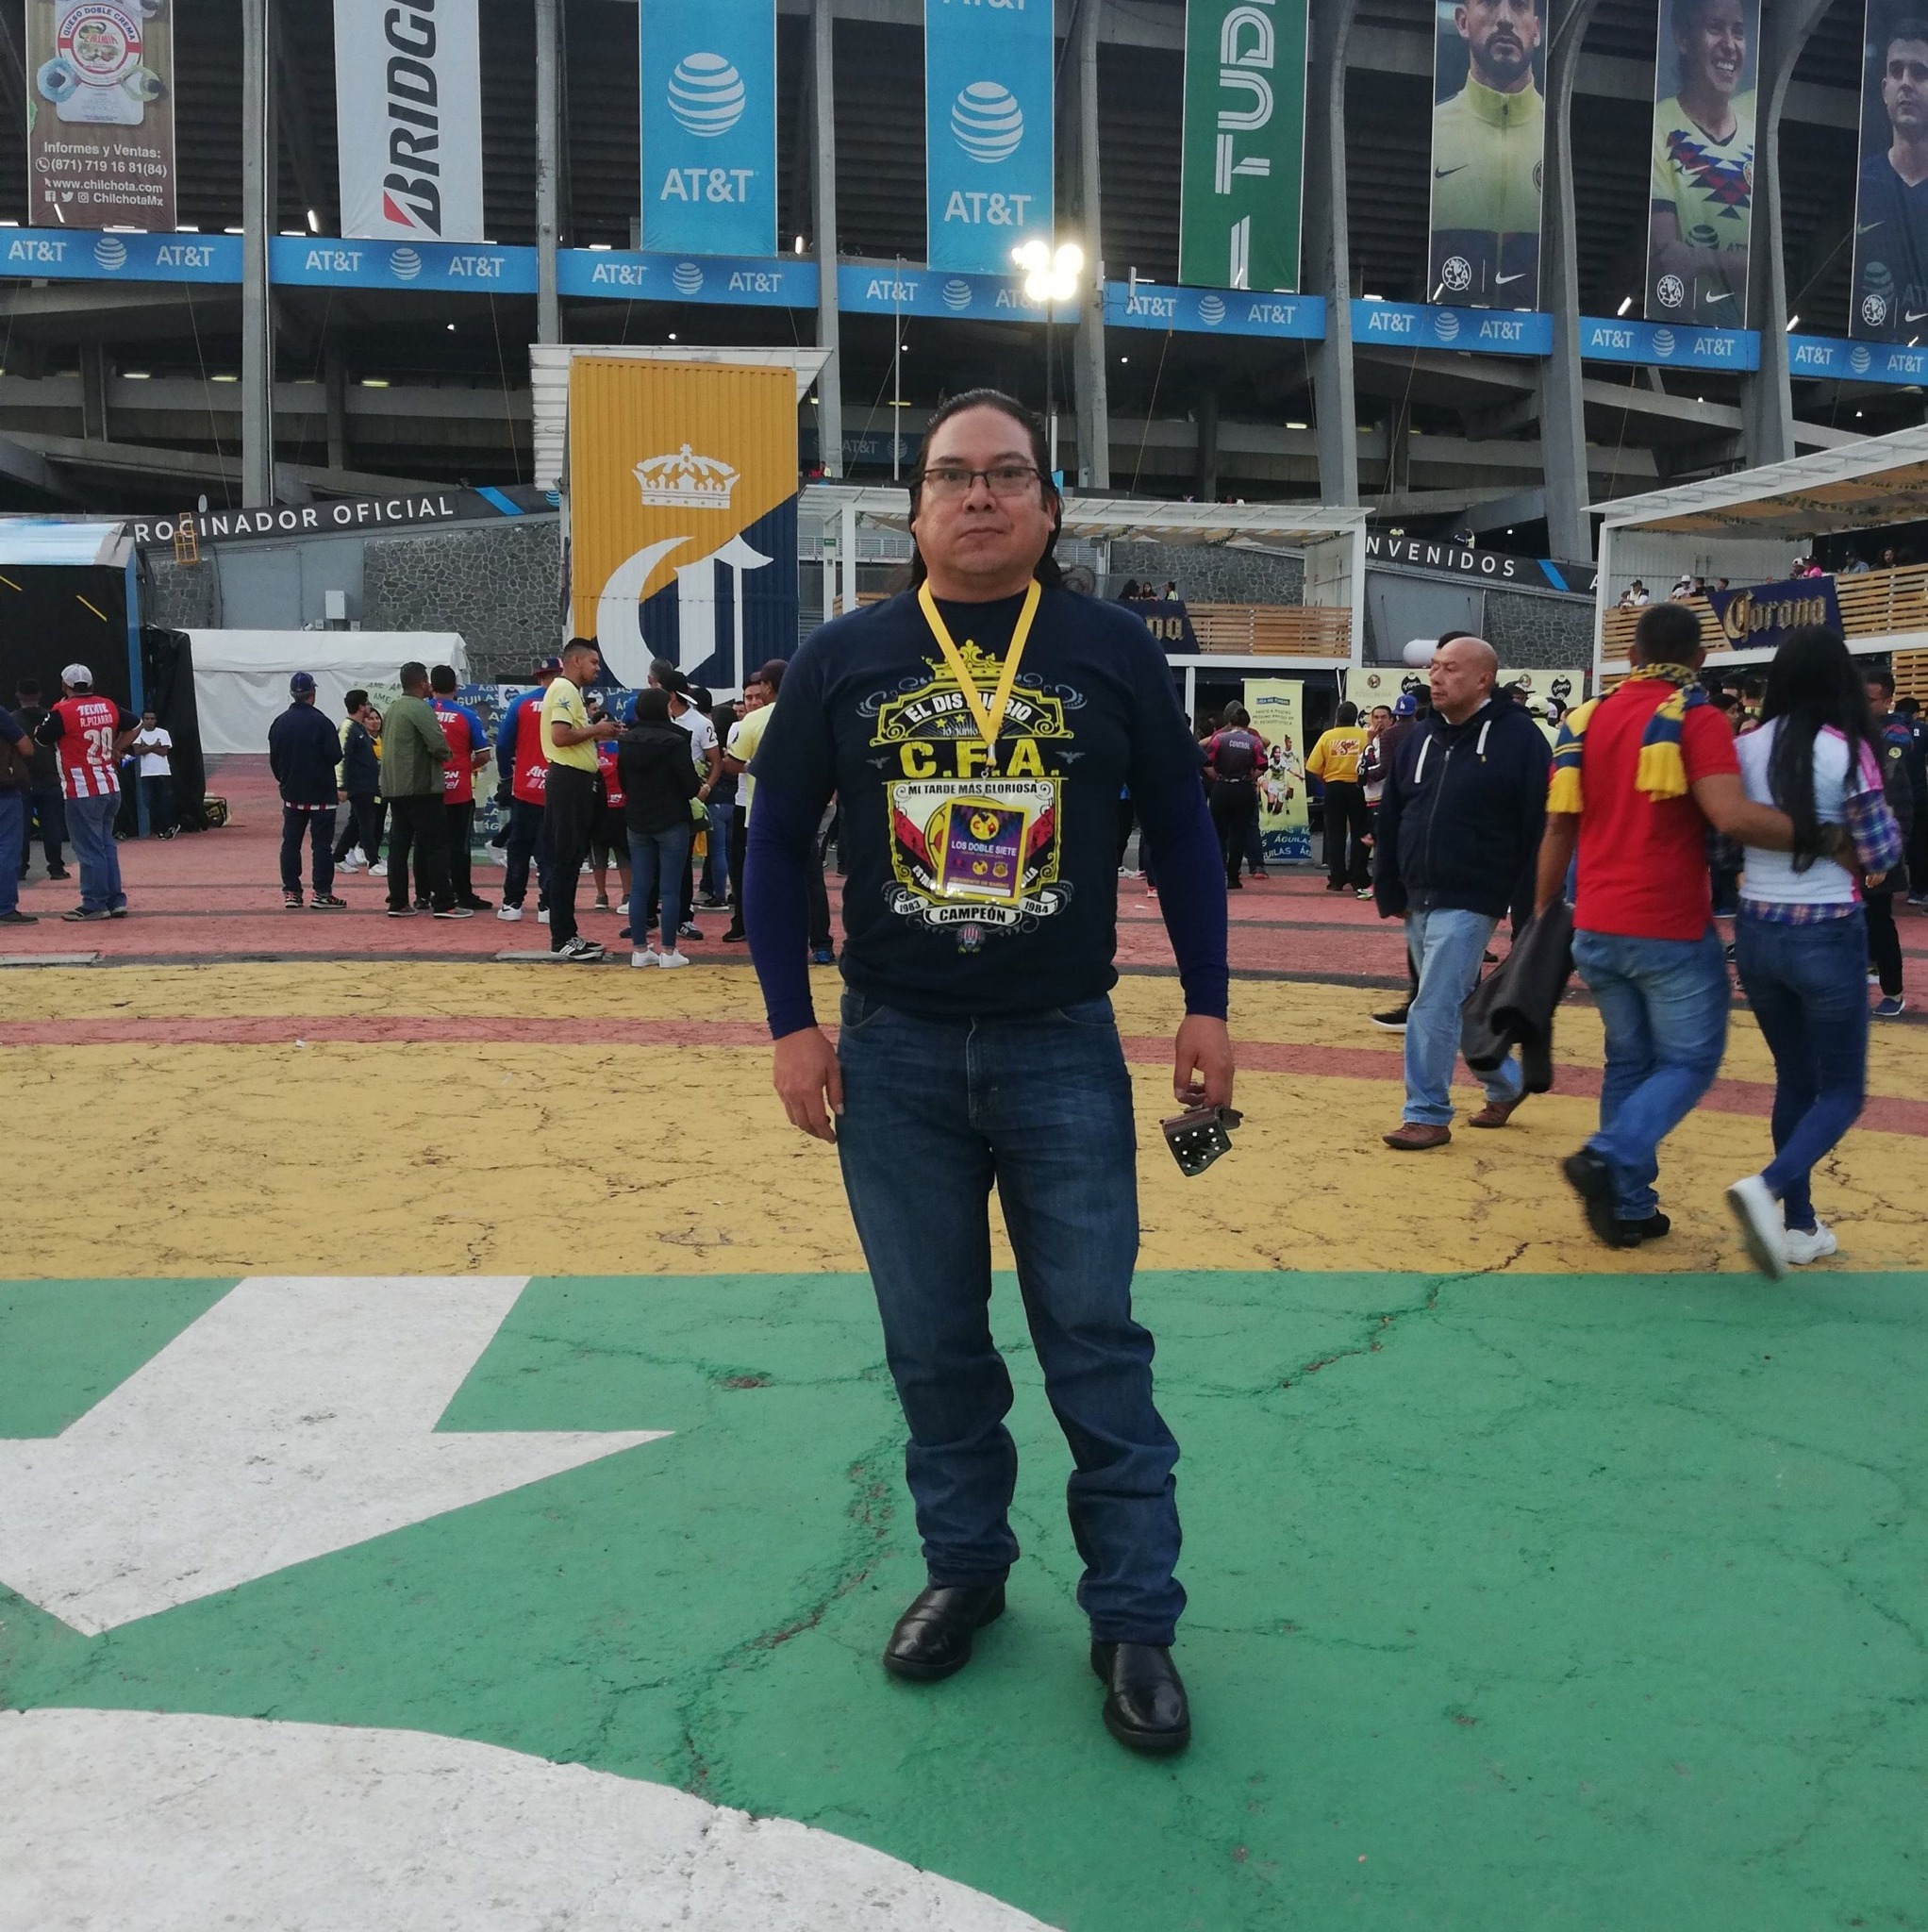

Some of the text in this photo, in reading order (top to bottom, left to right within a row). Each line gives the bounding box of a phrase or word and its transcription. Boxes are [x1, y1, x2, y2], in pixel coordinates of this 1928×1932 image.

[63, 7, 136, 41] QUESO DOBLE CREMA
[1215, 0, 1275, 194] TUD
[382, 0, 440, 237] BRIDG
[44, 142, 161, 158] Informes y Ventas:
[51, 158, 83, 173] (871)
[85, 159, 108, 172] 719
[111, 161, 125, 173] 16
[53, 179, 163, 193] www.chilchota.com
[661, 168, 755, 203] AT&T
[93, 192, 164, 207] ChilchotaMx
[944, 191, 1032, 226] AT&T
[8, 241, 67, 262] AT&T
[157, 246, 215, 267] AT&T
[306, 251, 363, 273] AT&T
[449, 257, 505, 277] AT&T
[592, 264, 648, 285] AT&T
[729, 272, 783, 292] AT&T
[867, 280, 918, 302] AT&T
[1126, 296, 1177, 317] AT&T
[1248, 304, 1296, 325] AT&T
[1369, 312, 1416, 333] AT&T
[1479, 321, 1524, 341] AT&T
[1591, 328, 1635, 349] AT&T
[1694, 337, 1735, 357] AT&T
[1795, 345, 1834, 365] AT&T
[1887, 355, 1924, 373] AT&T
[334, 496, 454, 525] OFICIAL
[1366, 536, 1516, 577] NVENIDOS
[1723, 590, 1826, 643] Corona
[76, 703, 109, 716] TECATE
[904, 704, 933, 723] EL
[83, 726, 113, 765] 20
[1229, 740, 1251, 750] CONTROL
[899, 739, 1060, 778] C.F.A.
[908, 783, 1038, 795] MI TARDE MÁS GLORIOSA
[951, 841, 967, 851] LOS
[968, 842, 994, 854] DOBLE
[995, 845, 1018, 857] SIETE
[899, 901, 922, 913] 1983
[939, 906, 1006, 922] CAMPEÓN
[1024, 901, 1049, 914] 1984
